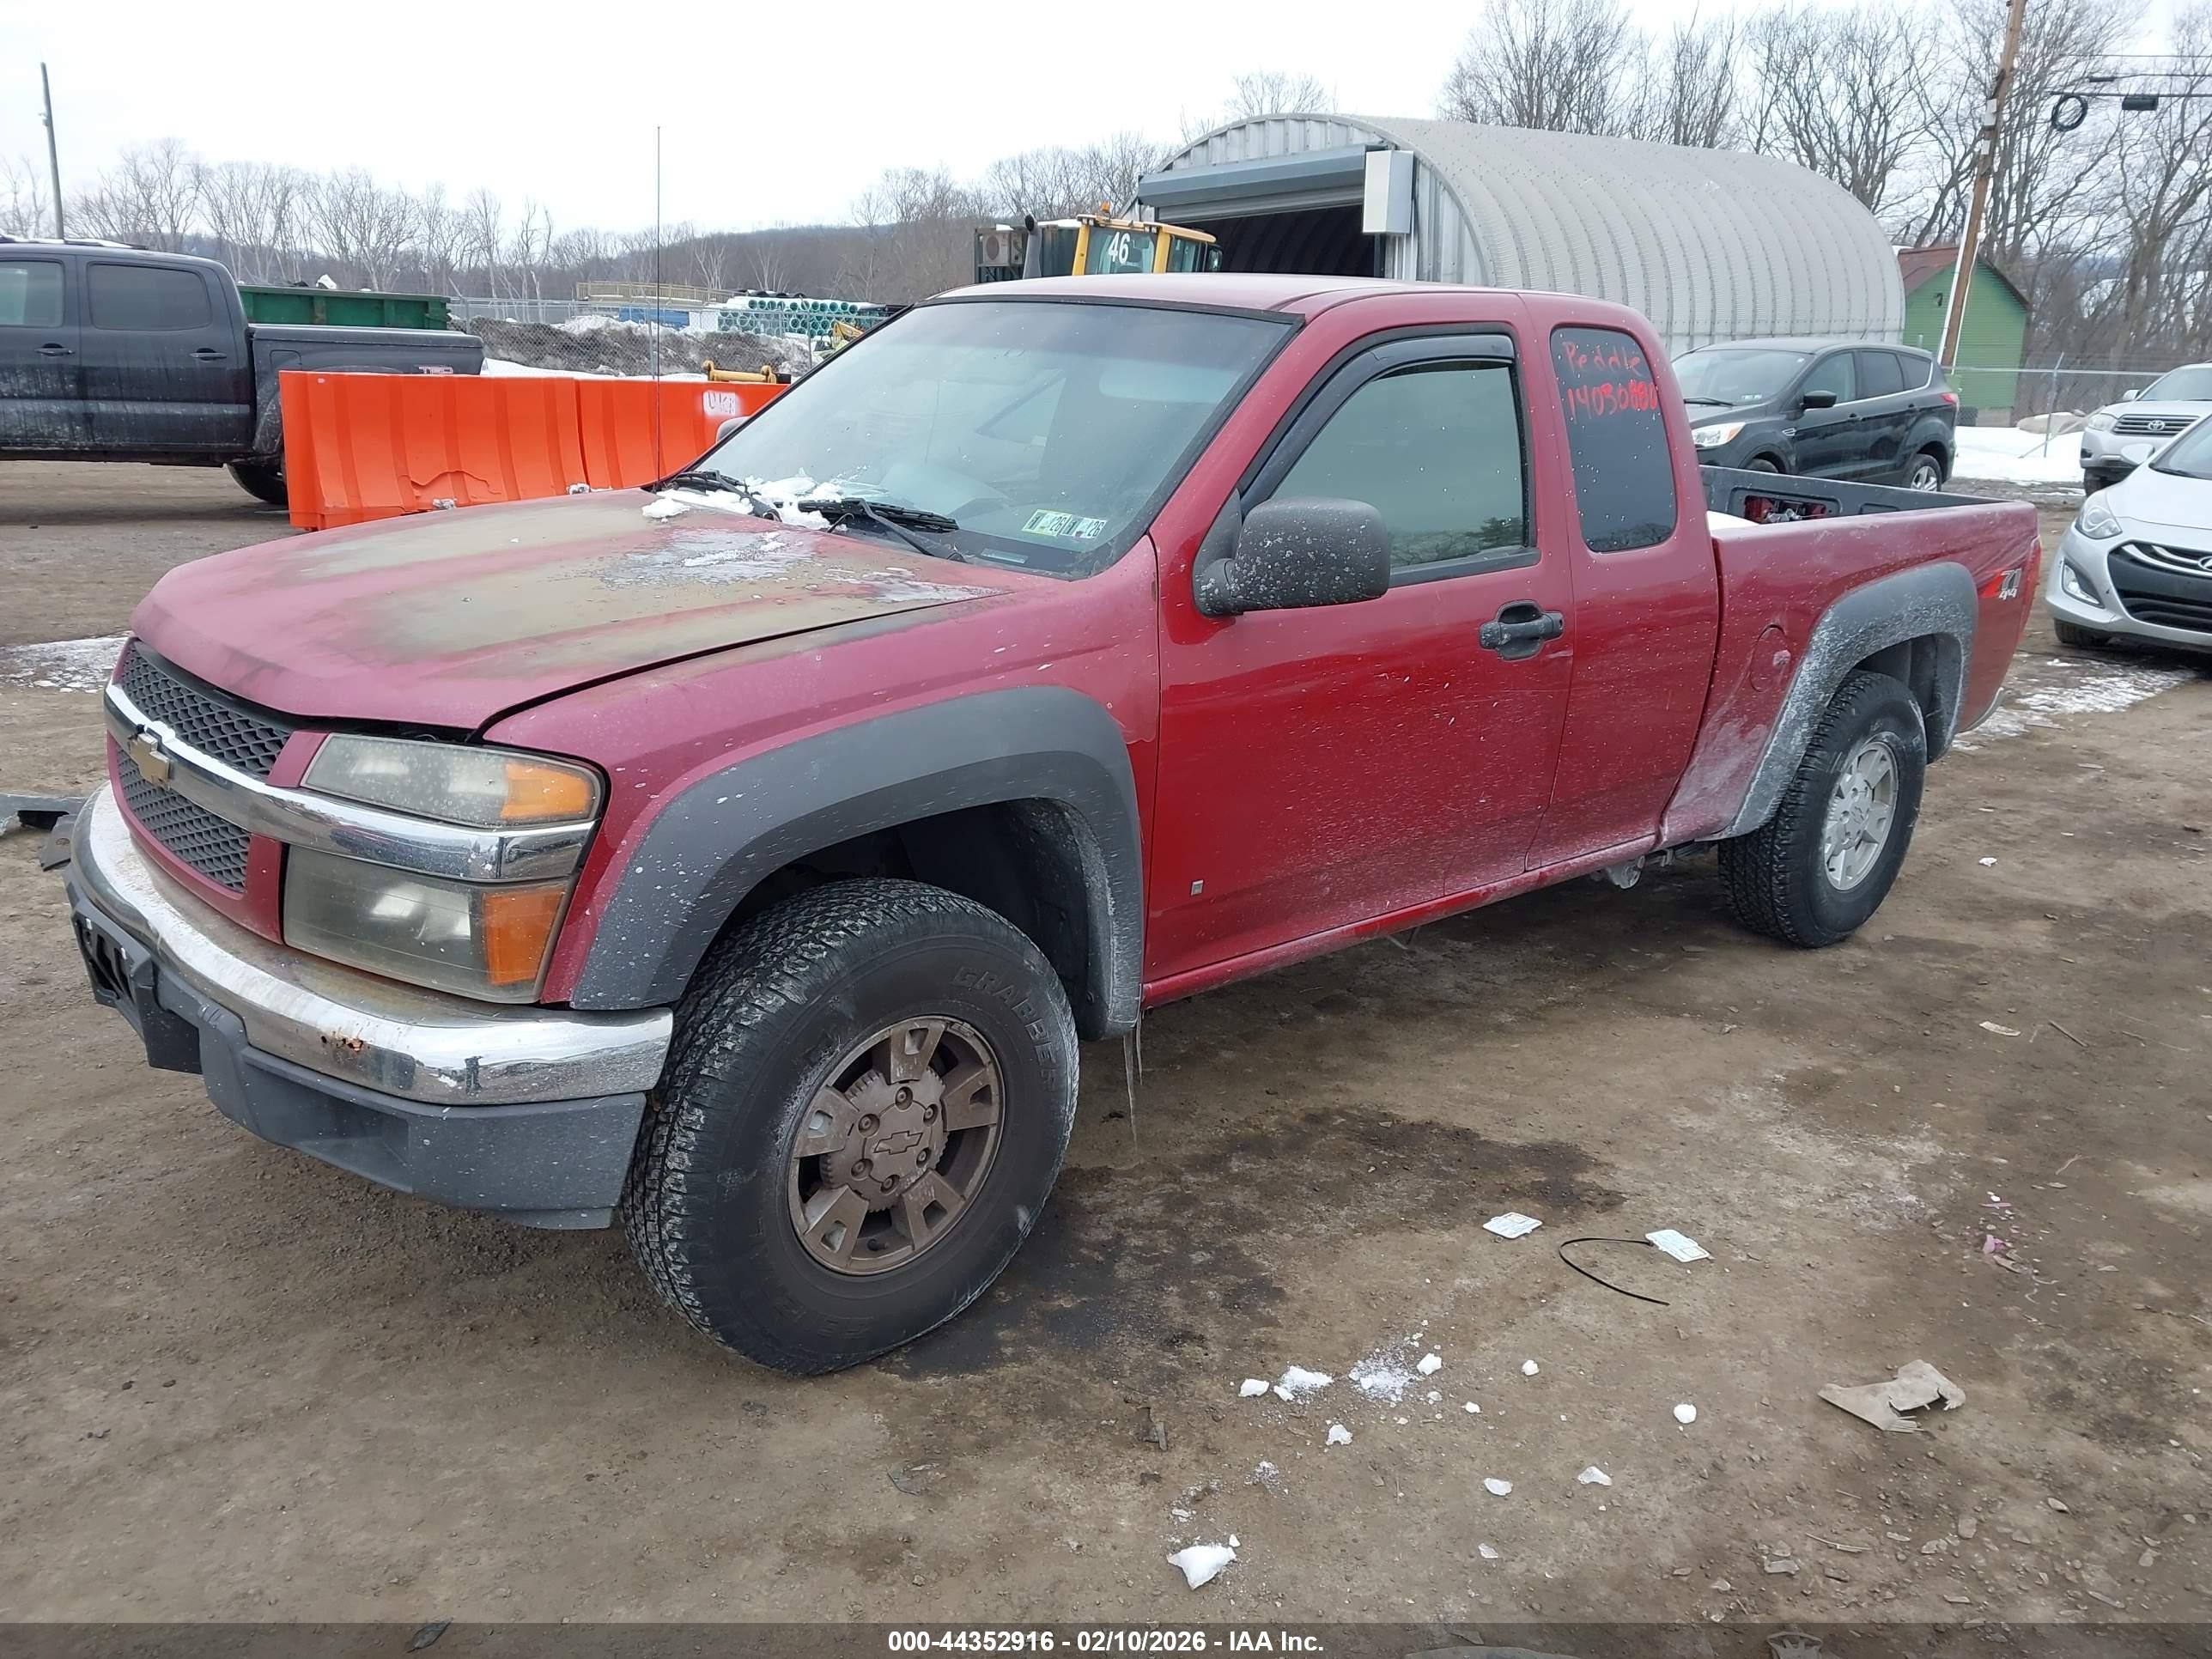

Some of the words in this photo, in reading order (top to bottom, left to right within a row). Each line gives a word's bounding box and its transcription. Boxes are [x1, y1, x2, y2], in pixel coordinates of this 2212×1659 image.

[1108, 231, 1131, 264] 46
[1562, 341, 1644, 377] Peddle
[1049, 516, 1067, 532] 26
[1086, 520, 1105, 537] 26
[951, 963, 1061, 1091] GRABBER
